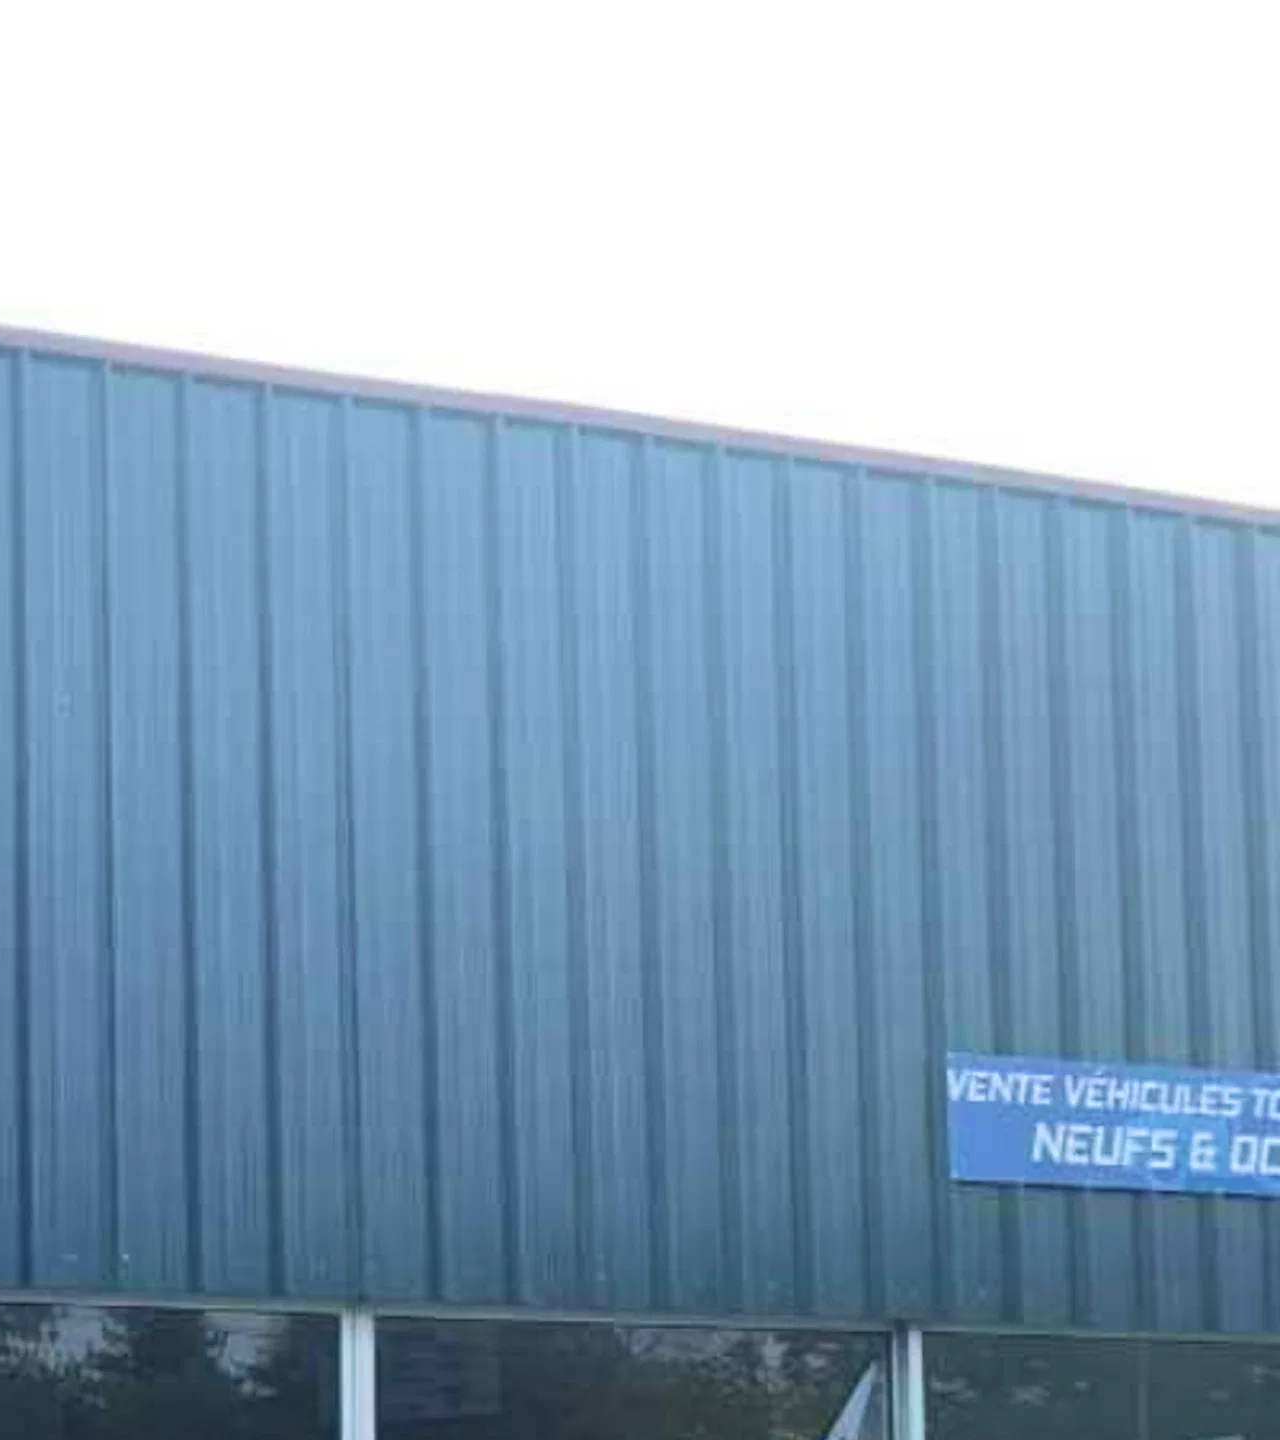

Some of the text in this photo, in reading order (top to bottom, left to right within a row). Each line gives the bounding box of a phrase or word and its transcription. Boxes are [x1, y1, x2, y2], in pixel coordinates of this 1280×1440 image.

[947, 1069, 1054, 1106] VENTE
[1064, 1068, 1244, 1117] VÉHICULES
[1032, 1122, 1178, 1169] NEUFS
[1190, 1131, 1218, 1173] &
